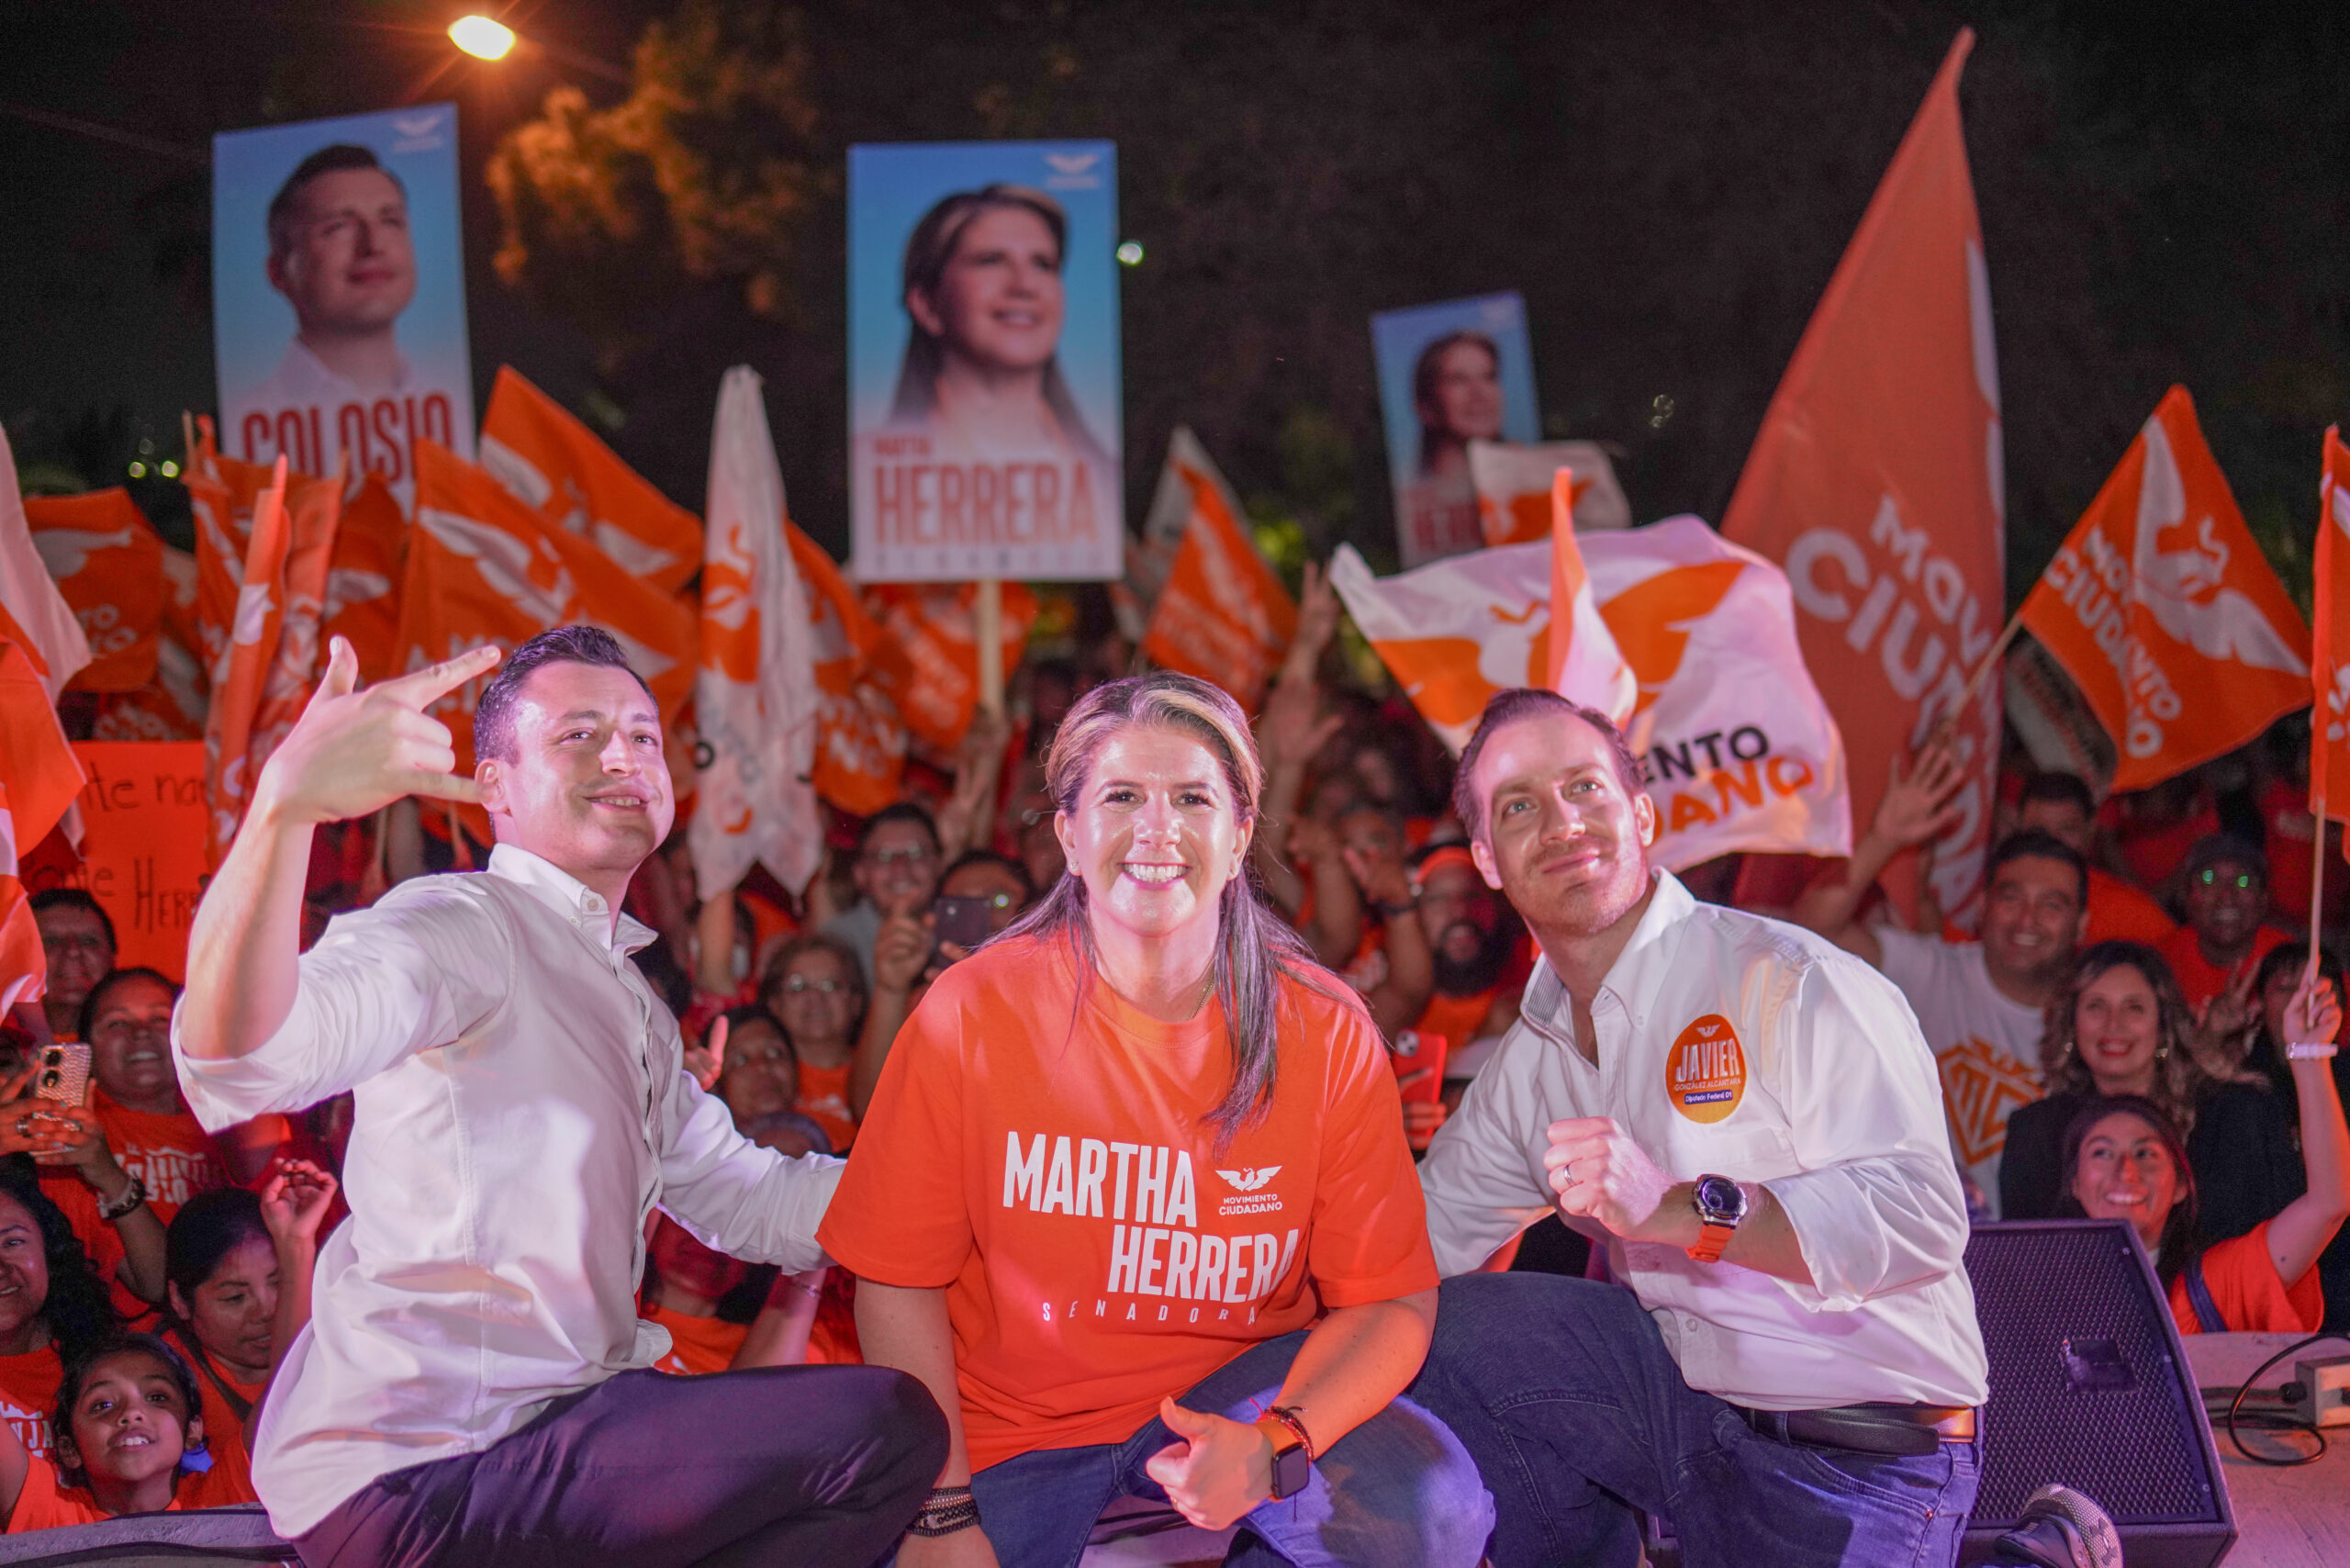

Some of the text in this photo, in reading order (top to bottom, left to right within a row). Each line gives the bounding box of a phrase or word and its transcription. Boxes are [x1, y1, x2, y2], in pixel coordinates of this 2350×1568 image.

[874, 462, 1097, 543] HERRERA
[1674, 1037, 1741, 1083] JAVIER
[1002, 1131, 1197, 1227] MARTHA
[1222, 1193, 1278, 1205] MOVIMIENTO
[1218, 1203, 1283, 1215] CIUDADANO
[1107, 1225, 1300, 1304] HERRERA
[1042, 1300, 1257, 1326] SENADORA
